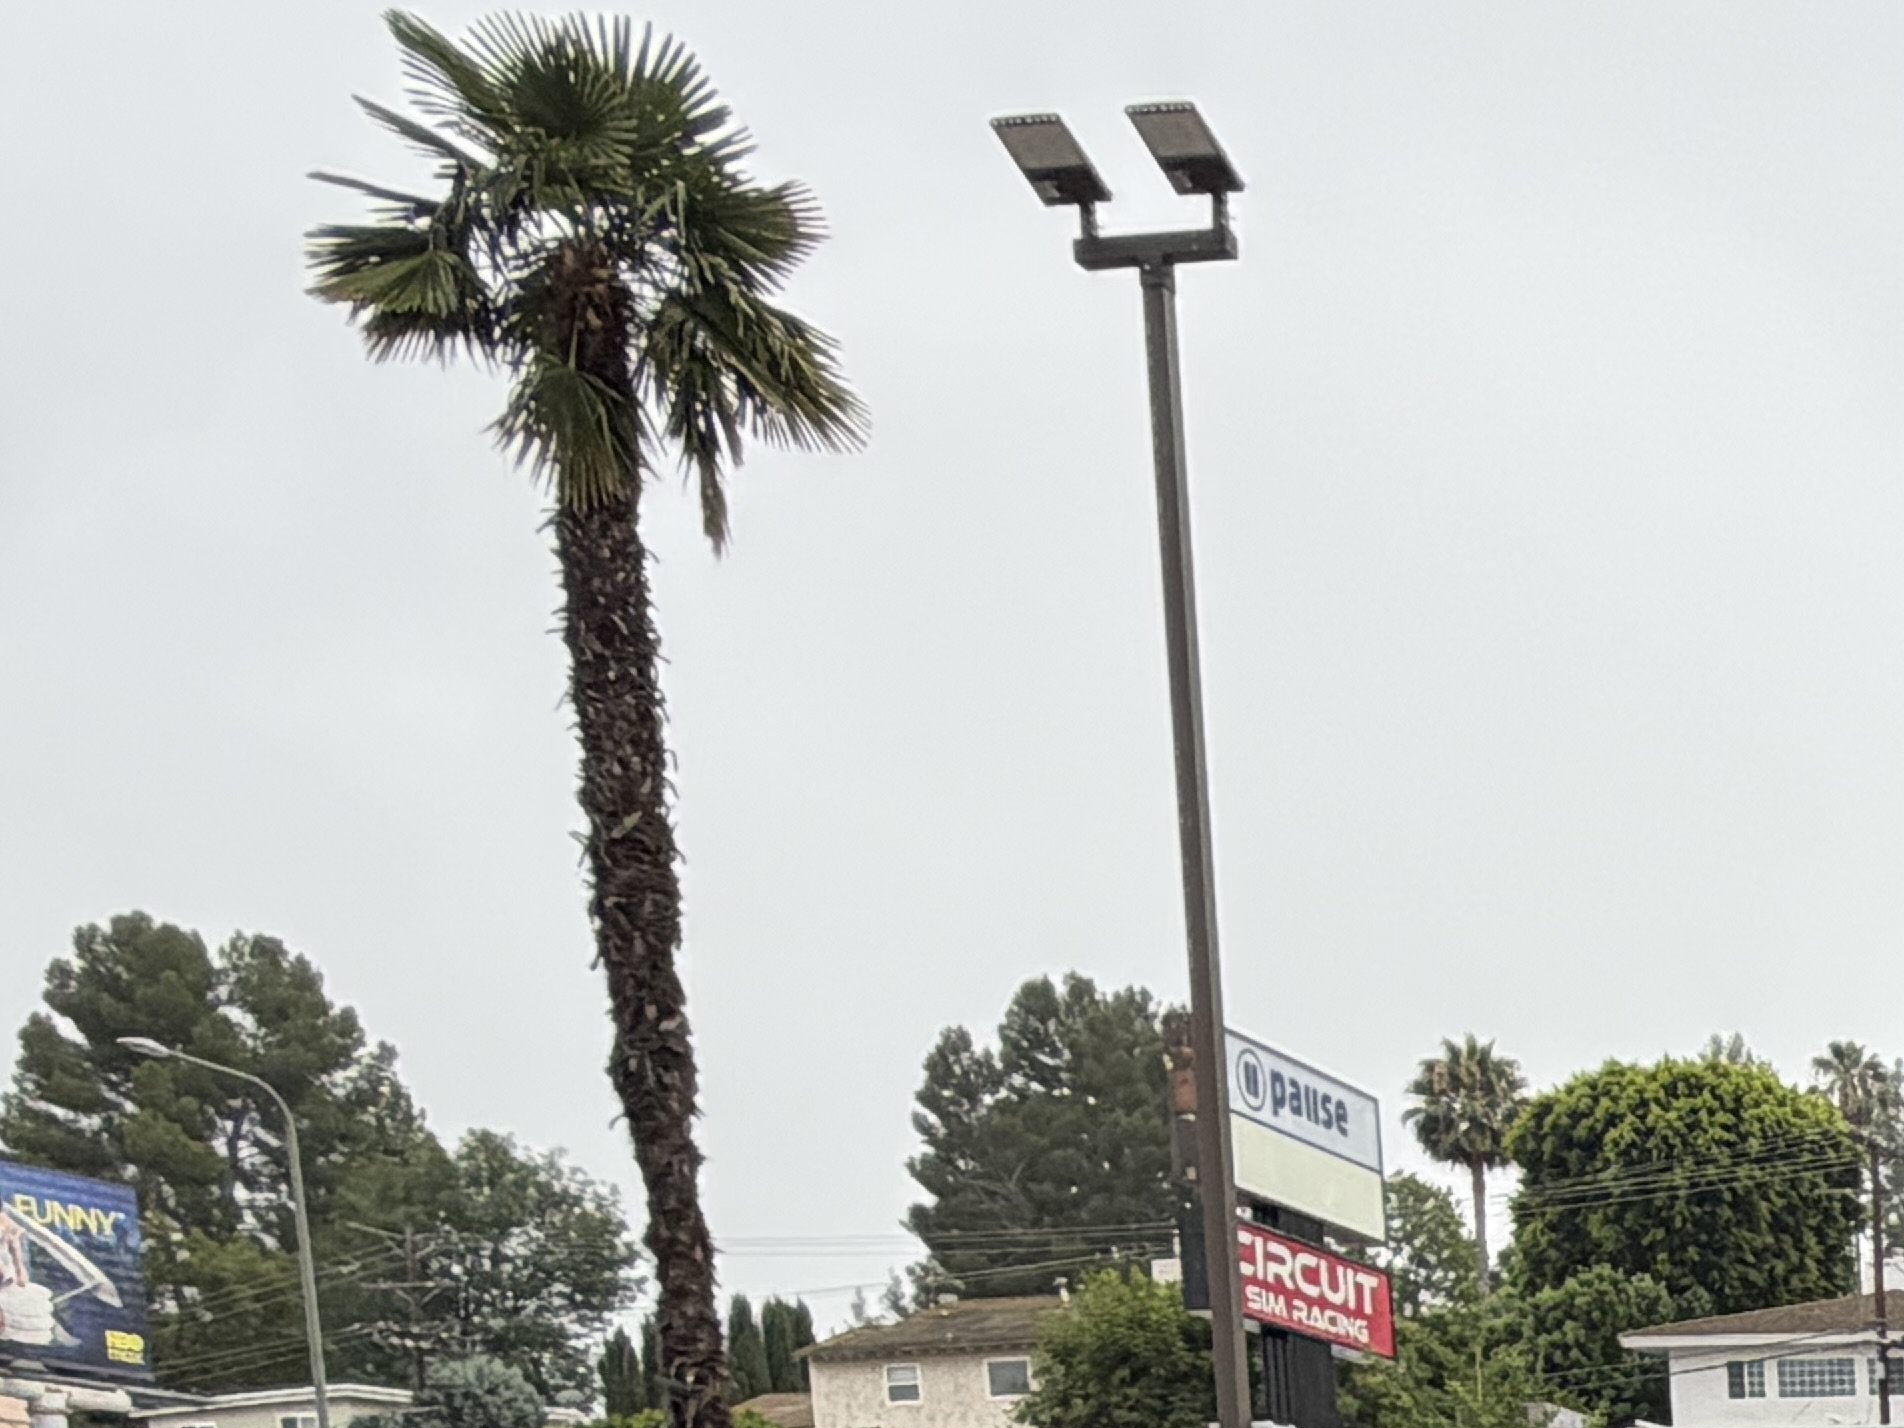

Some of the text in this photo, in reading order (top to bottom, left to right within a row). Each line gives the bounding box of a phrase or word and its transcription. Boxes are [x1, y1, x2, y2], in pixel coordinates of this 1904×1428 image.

[1270, 1068, 1349, 1138] pause
[1244, 1283, 1370, 1345] SIM RACING
